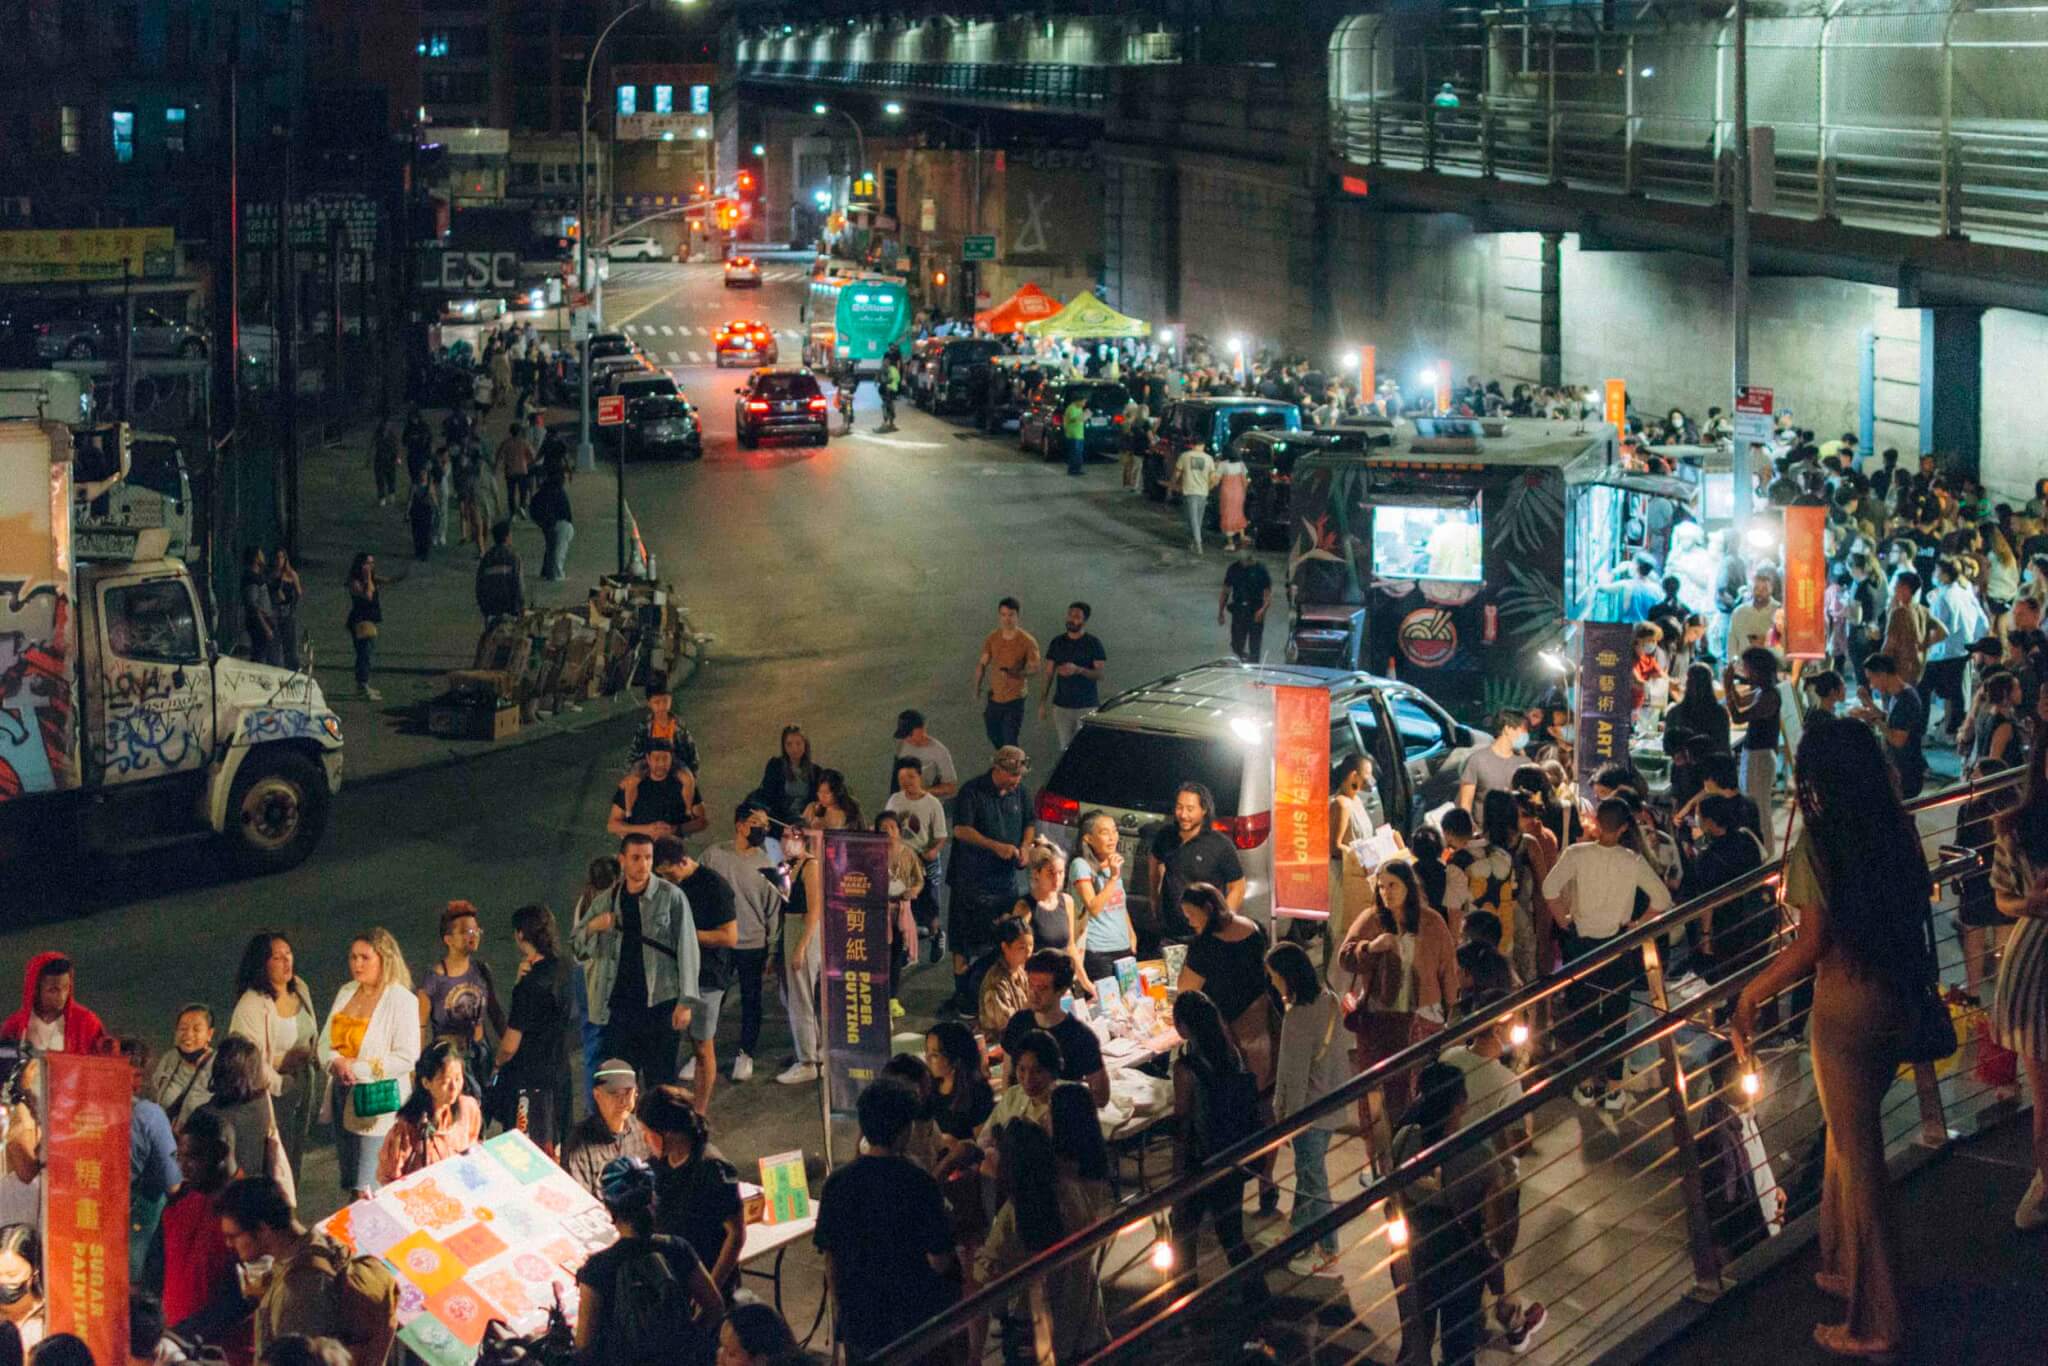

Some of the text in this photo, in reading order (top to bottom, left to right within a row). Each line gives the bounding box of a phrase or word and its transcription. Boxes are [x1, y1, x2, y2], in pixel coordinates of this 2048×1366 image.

[1597, 720, 1612, 757] ART
[1293, 810, 1308, 863] SHOP
[846, 909, 868, 961] 剪紙
[845, 970, 860, 1044] CUTTING
[859, 971, 873, 1025] PAPER
[89, 1242, 105, 1317] SUGAR
